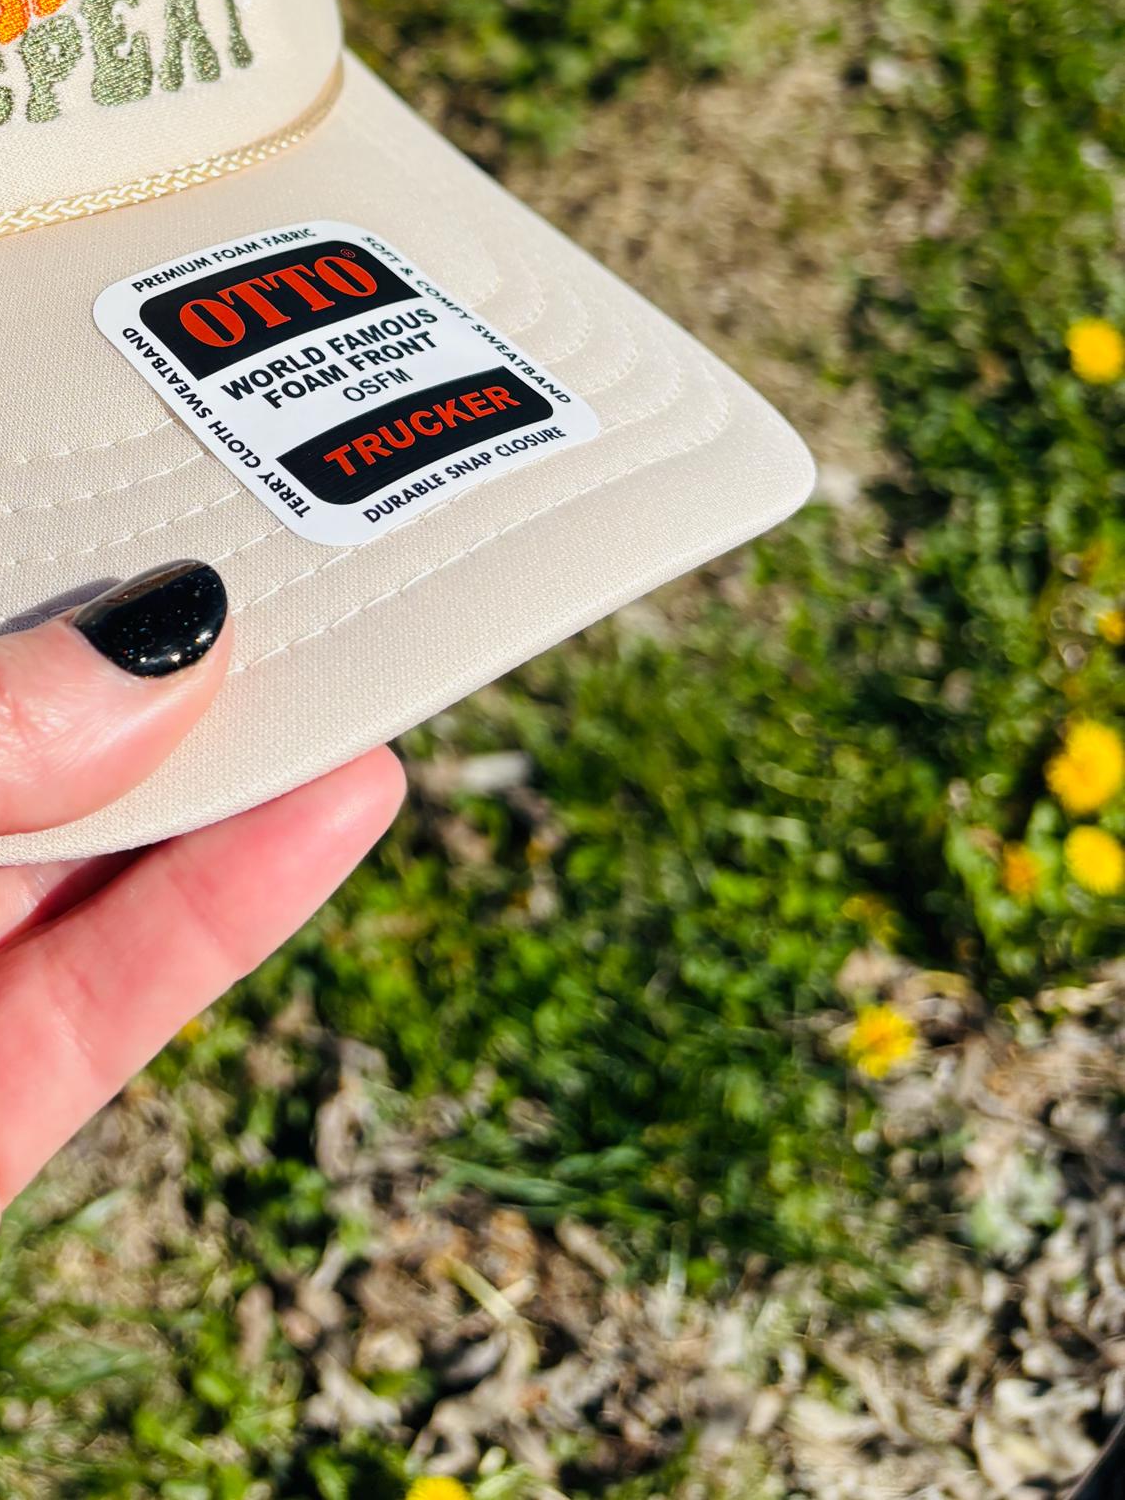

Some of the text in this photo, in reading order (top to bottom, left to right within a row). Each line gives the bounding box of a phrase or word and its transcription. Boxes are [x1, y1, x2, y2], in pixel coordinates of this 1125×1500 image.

[131, 228, 317, 293] PREMIUM FOAM FABRIC
[179, 255, 378, 348] OTTO
[220, 308, 438, 401] WORLD FAMOUS
[362, 236, 571, 404] SOFT & COMFY SWEATBAND
[262, 332, 438, 410] FOAM FRONT
[343, 367, 414, 403] OSFM
[122, 327, 310, 519] TERRY CLOTH SWEATBAND
[323, 386, 521, 477] TRUCKER
[363, 426, 566, 523] DURABLE SNAP CLOSURE
